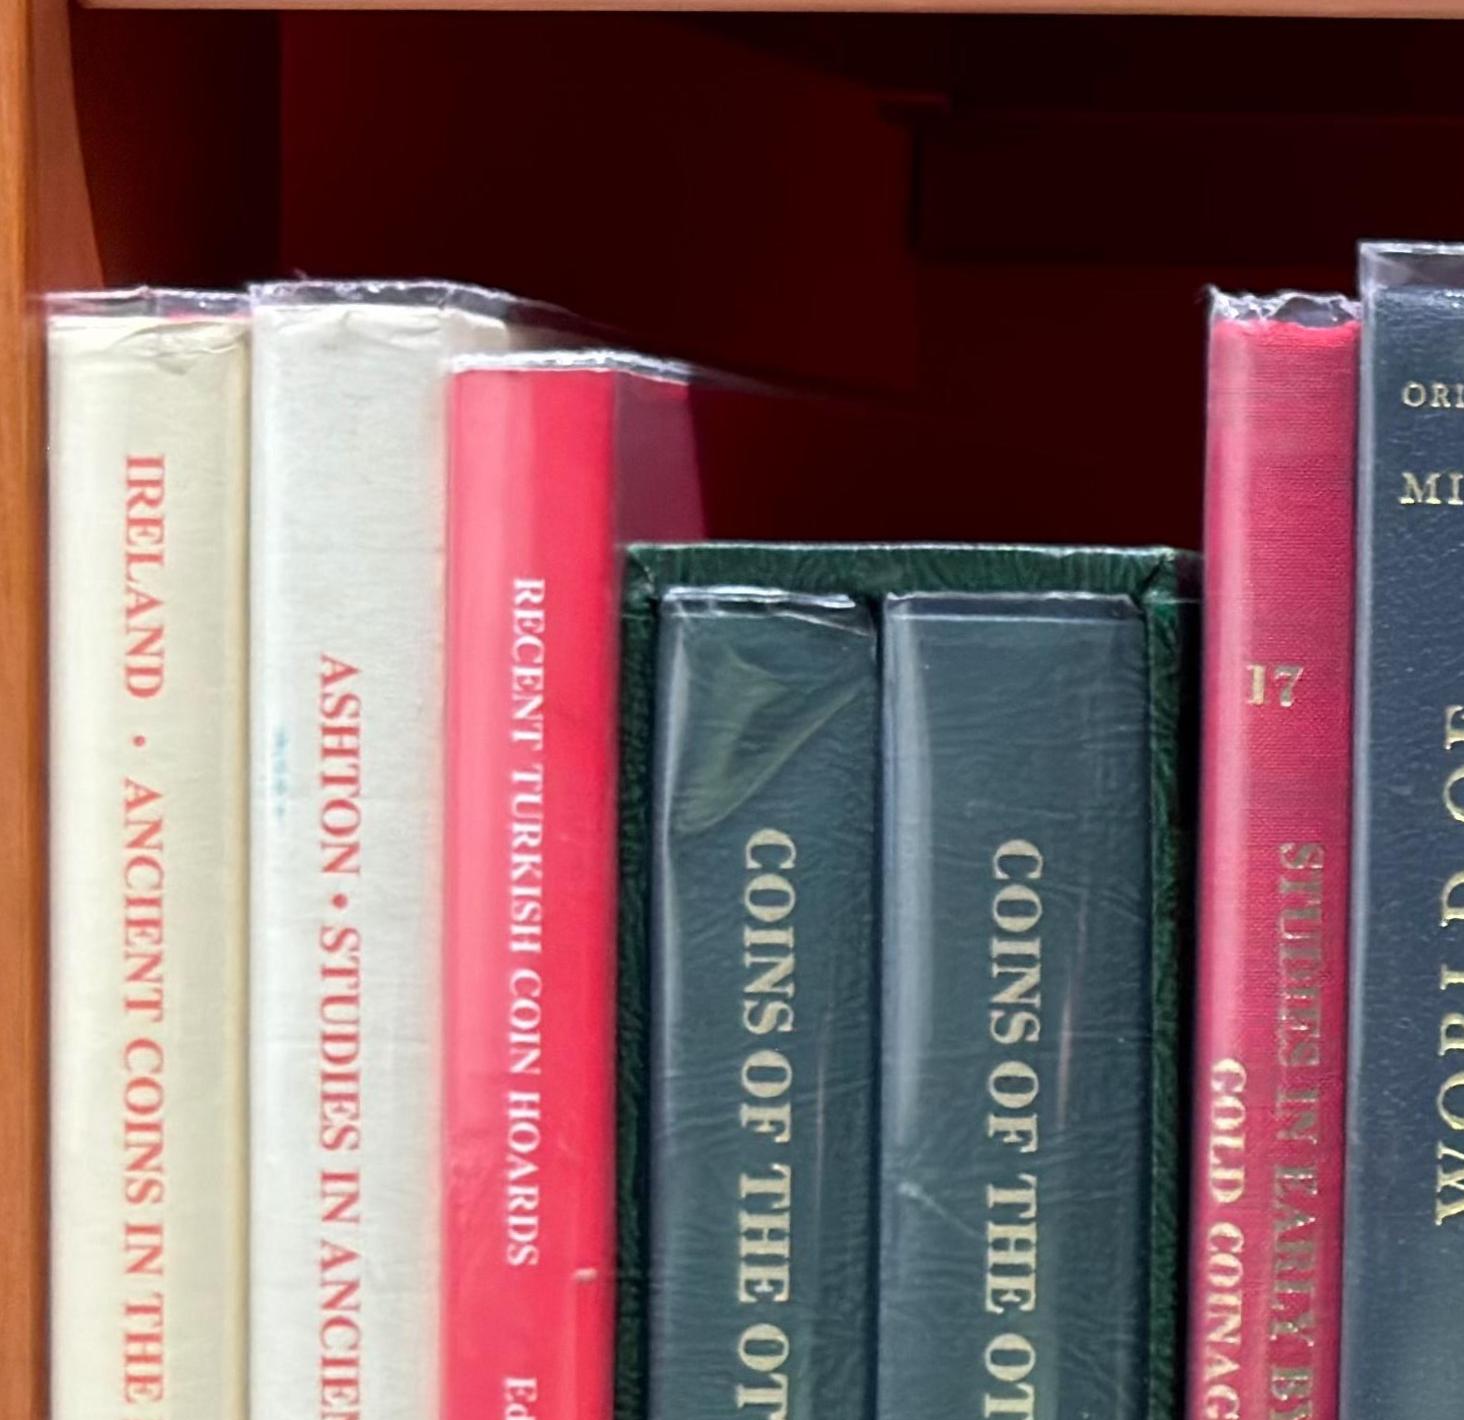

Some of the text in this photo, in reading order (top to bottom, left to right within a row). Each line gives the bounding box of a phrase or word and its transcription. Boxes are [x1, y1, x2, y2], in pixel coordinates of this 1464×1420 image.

[124, 454, 165, 699] IRELAND
[1246, 664, 1304, 707] 17
[319, 653, 361, 878] ASHTON
[122, 777, 165, 1024] ANCIENT
[505, 577, 546, 1267] RECENT TURKISH COIN HOARDS
[742, 828, 797, 1035] COINS
[989, 838, 1045, 1045] COINS
[1276, 842, 1325, 1067] STUDIES
[319, 926, 361, 1152] STUDIES
[740, 1050, 793, 1144] OF
[986, 1061, 1040, 1154] OF
[1273, 1087, 1319, 1145] IN
[122, 1037, 164, 1206] COINS
[319, 1169, 361, 1225] IN
[1207, 1057, 1248, 1205] GOLD
[123, 1222, 164, 1277] IN
[737, 1163, 792, 1304] THE
[984, 1176, 1038, 1314] THE
[1269, 1164, 1320, 1347] EARLY
[123, 1291, 164, 1402] THE
